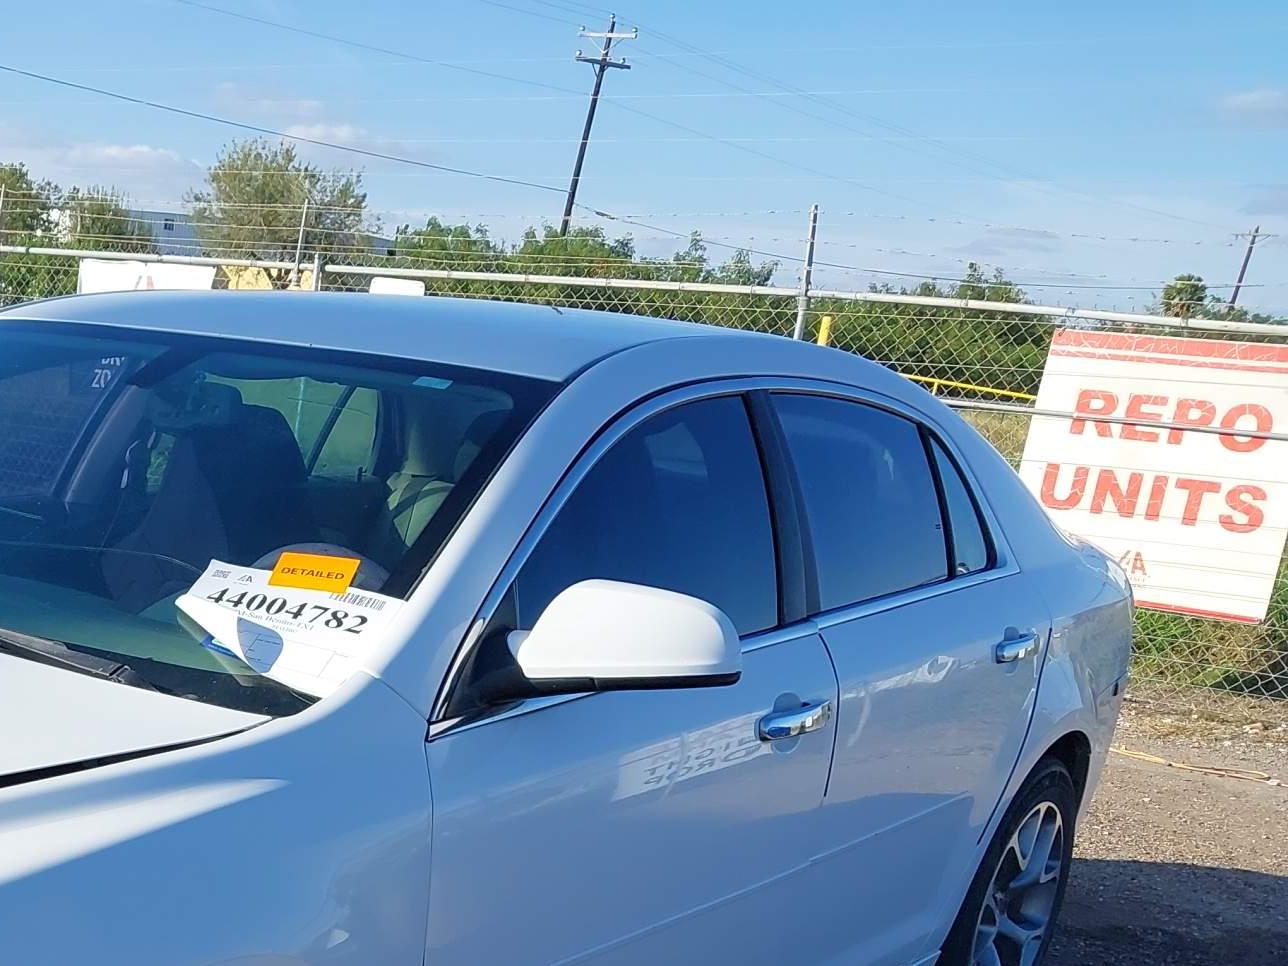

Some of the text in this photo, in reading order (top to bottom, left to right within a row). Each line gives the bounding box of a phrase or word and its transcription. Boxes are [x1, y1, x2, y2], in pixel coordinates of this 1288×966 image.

[1069, 388, 1273, 453] REPO
[1039, 462, 1268, 534] UNITS
[280, 566, 345, 581] DETAILED
[206, 586, 368, 635] 44004782
